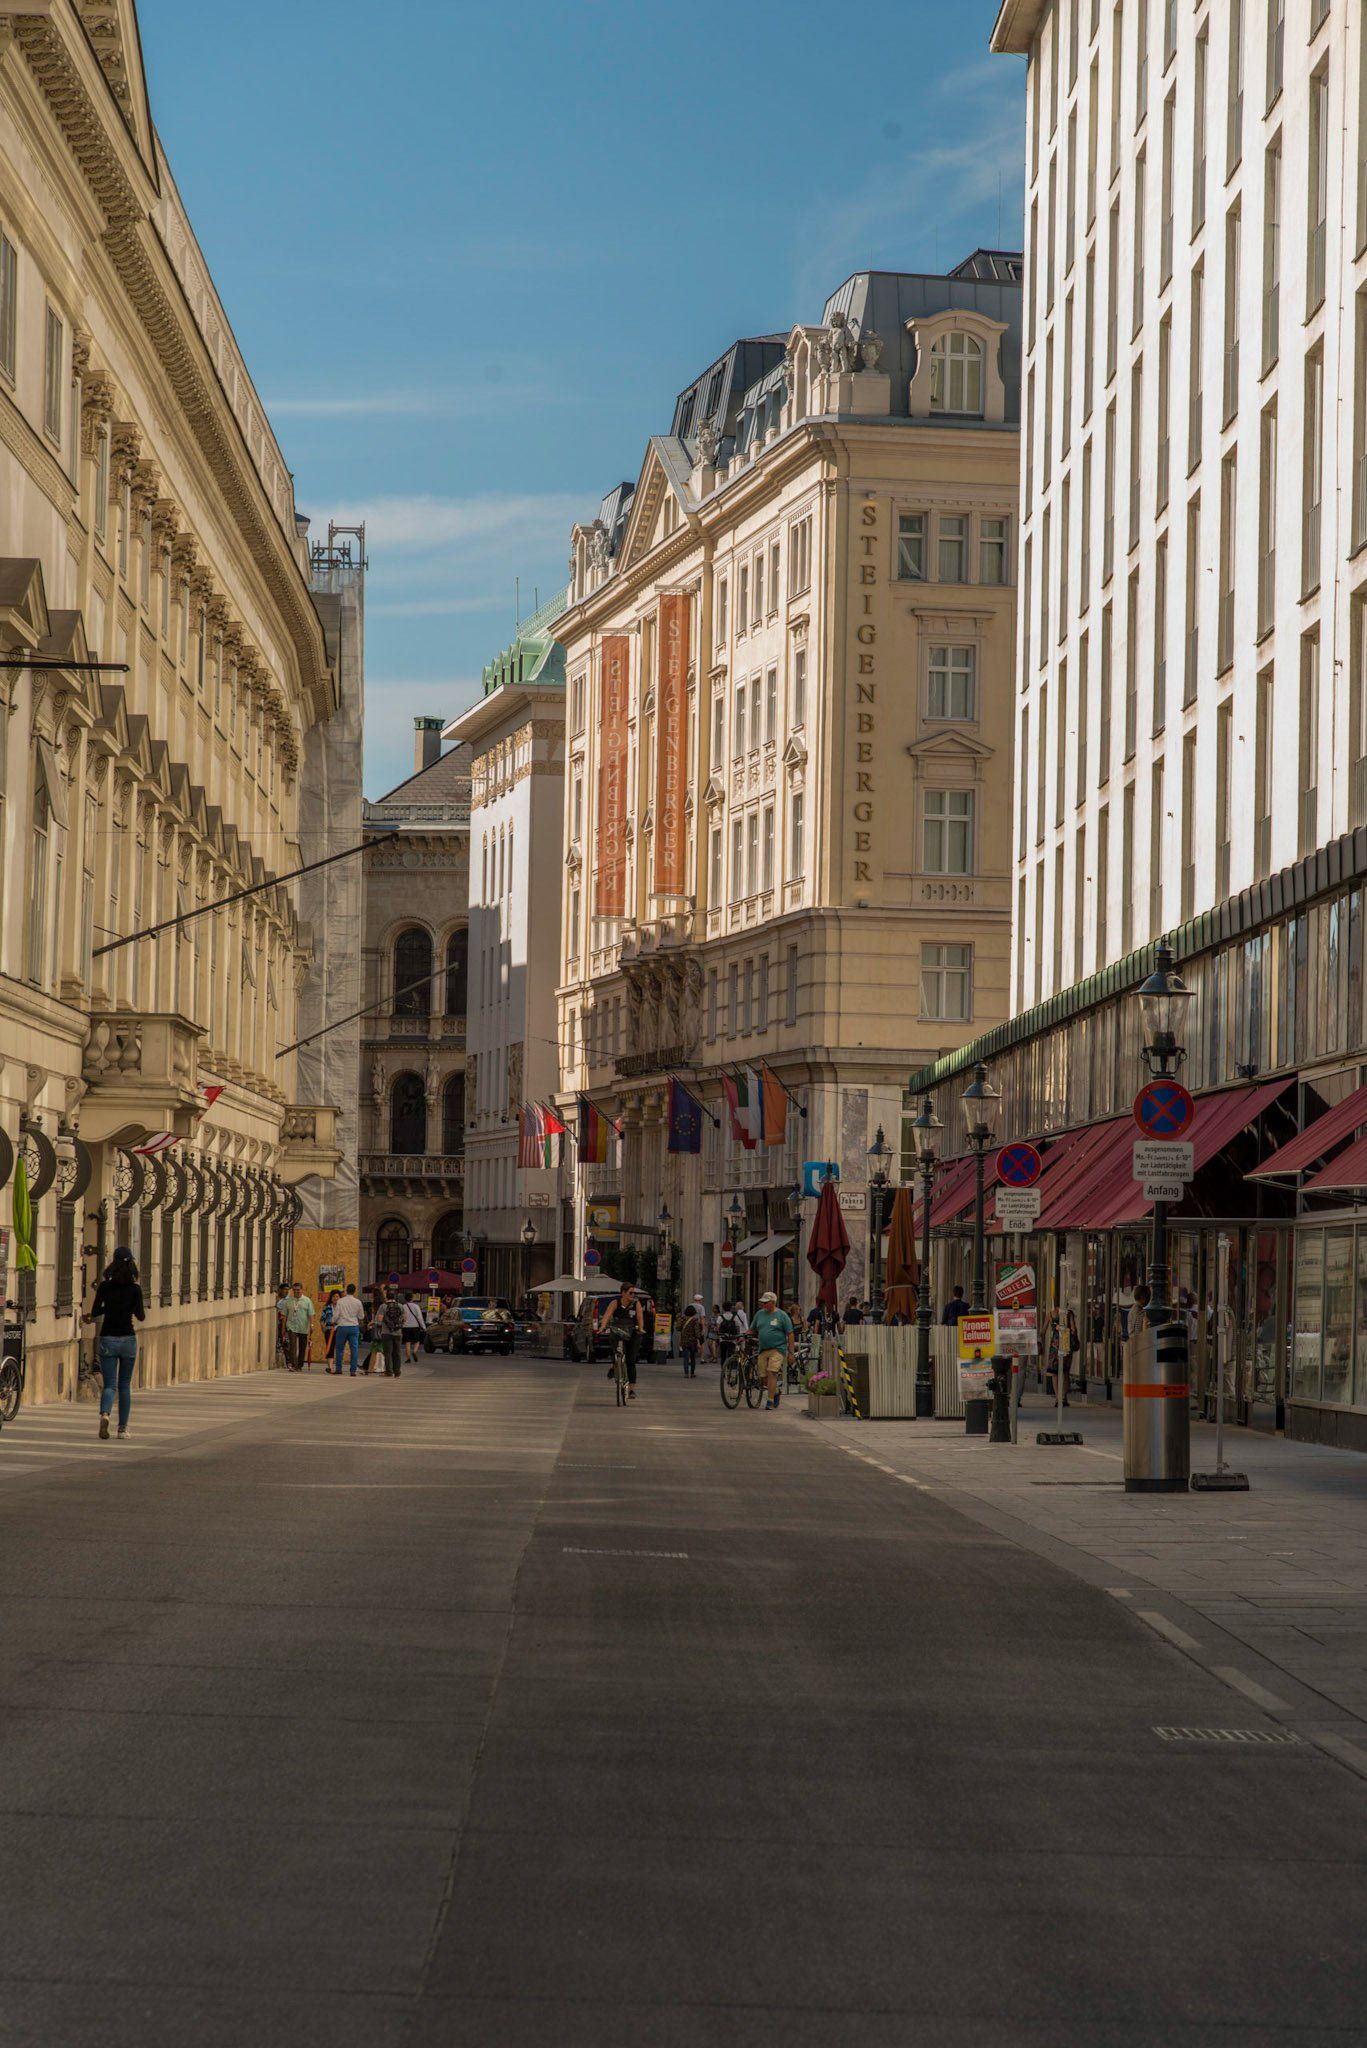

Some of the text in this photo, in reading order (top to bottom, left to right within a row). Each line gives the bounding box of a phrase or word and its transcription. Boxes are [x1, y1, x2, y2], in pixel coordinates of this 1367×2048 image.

[853, 505, 878, 882] STEIGENBERGER
[663, 619, 681, 868] STEIGENBERGER
[1147, 1185, 1179, 1198] Anfang
[1009, 1220, 1026, 1229] Ende
[998, 1278, 1031, 1298] KURIER
[962, 1321, 990, 1331] Kronen
[964, 1331, 991, 1341] Zeitung
